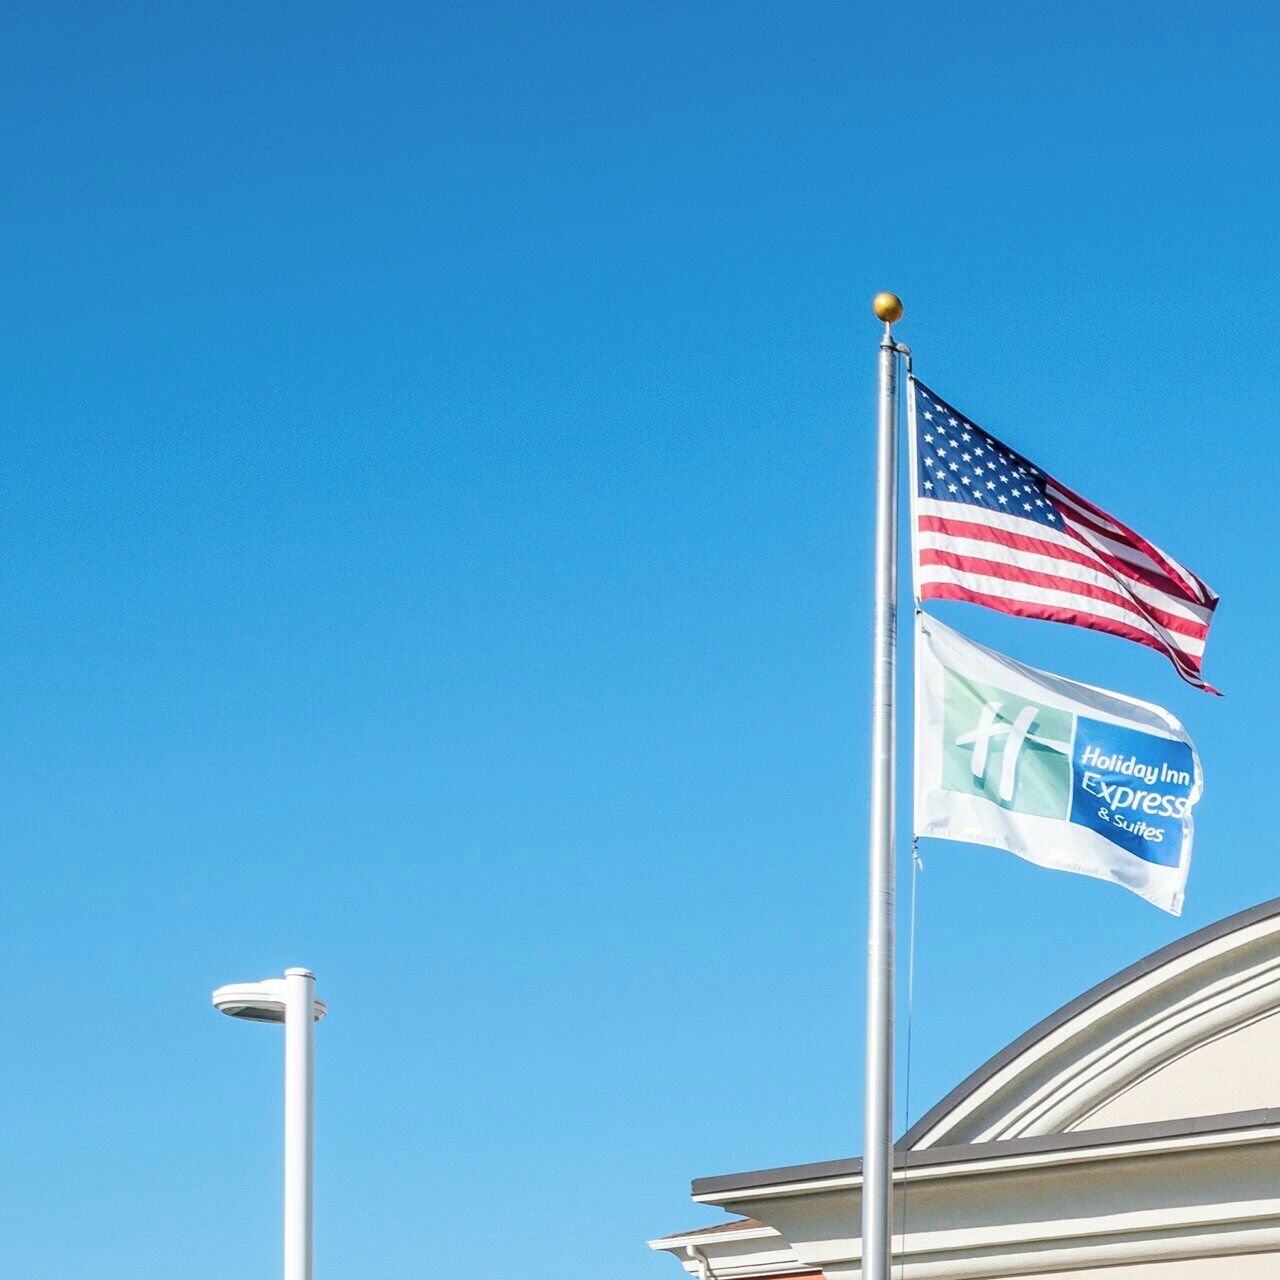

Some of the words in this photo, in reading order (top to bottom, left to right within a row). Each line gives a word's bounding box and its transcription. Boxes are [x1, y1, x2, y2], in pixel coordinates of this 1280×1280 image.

[1081, 745, 1157, 785] Holiday
[1161, 763, 1190, 786] Inn
[1081, 770, 1193, 819] Express
[1097, 806, 1110, 821] &
[1113, 815, 1165, 843] Suites
